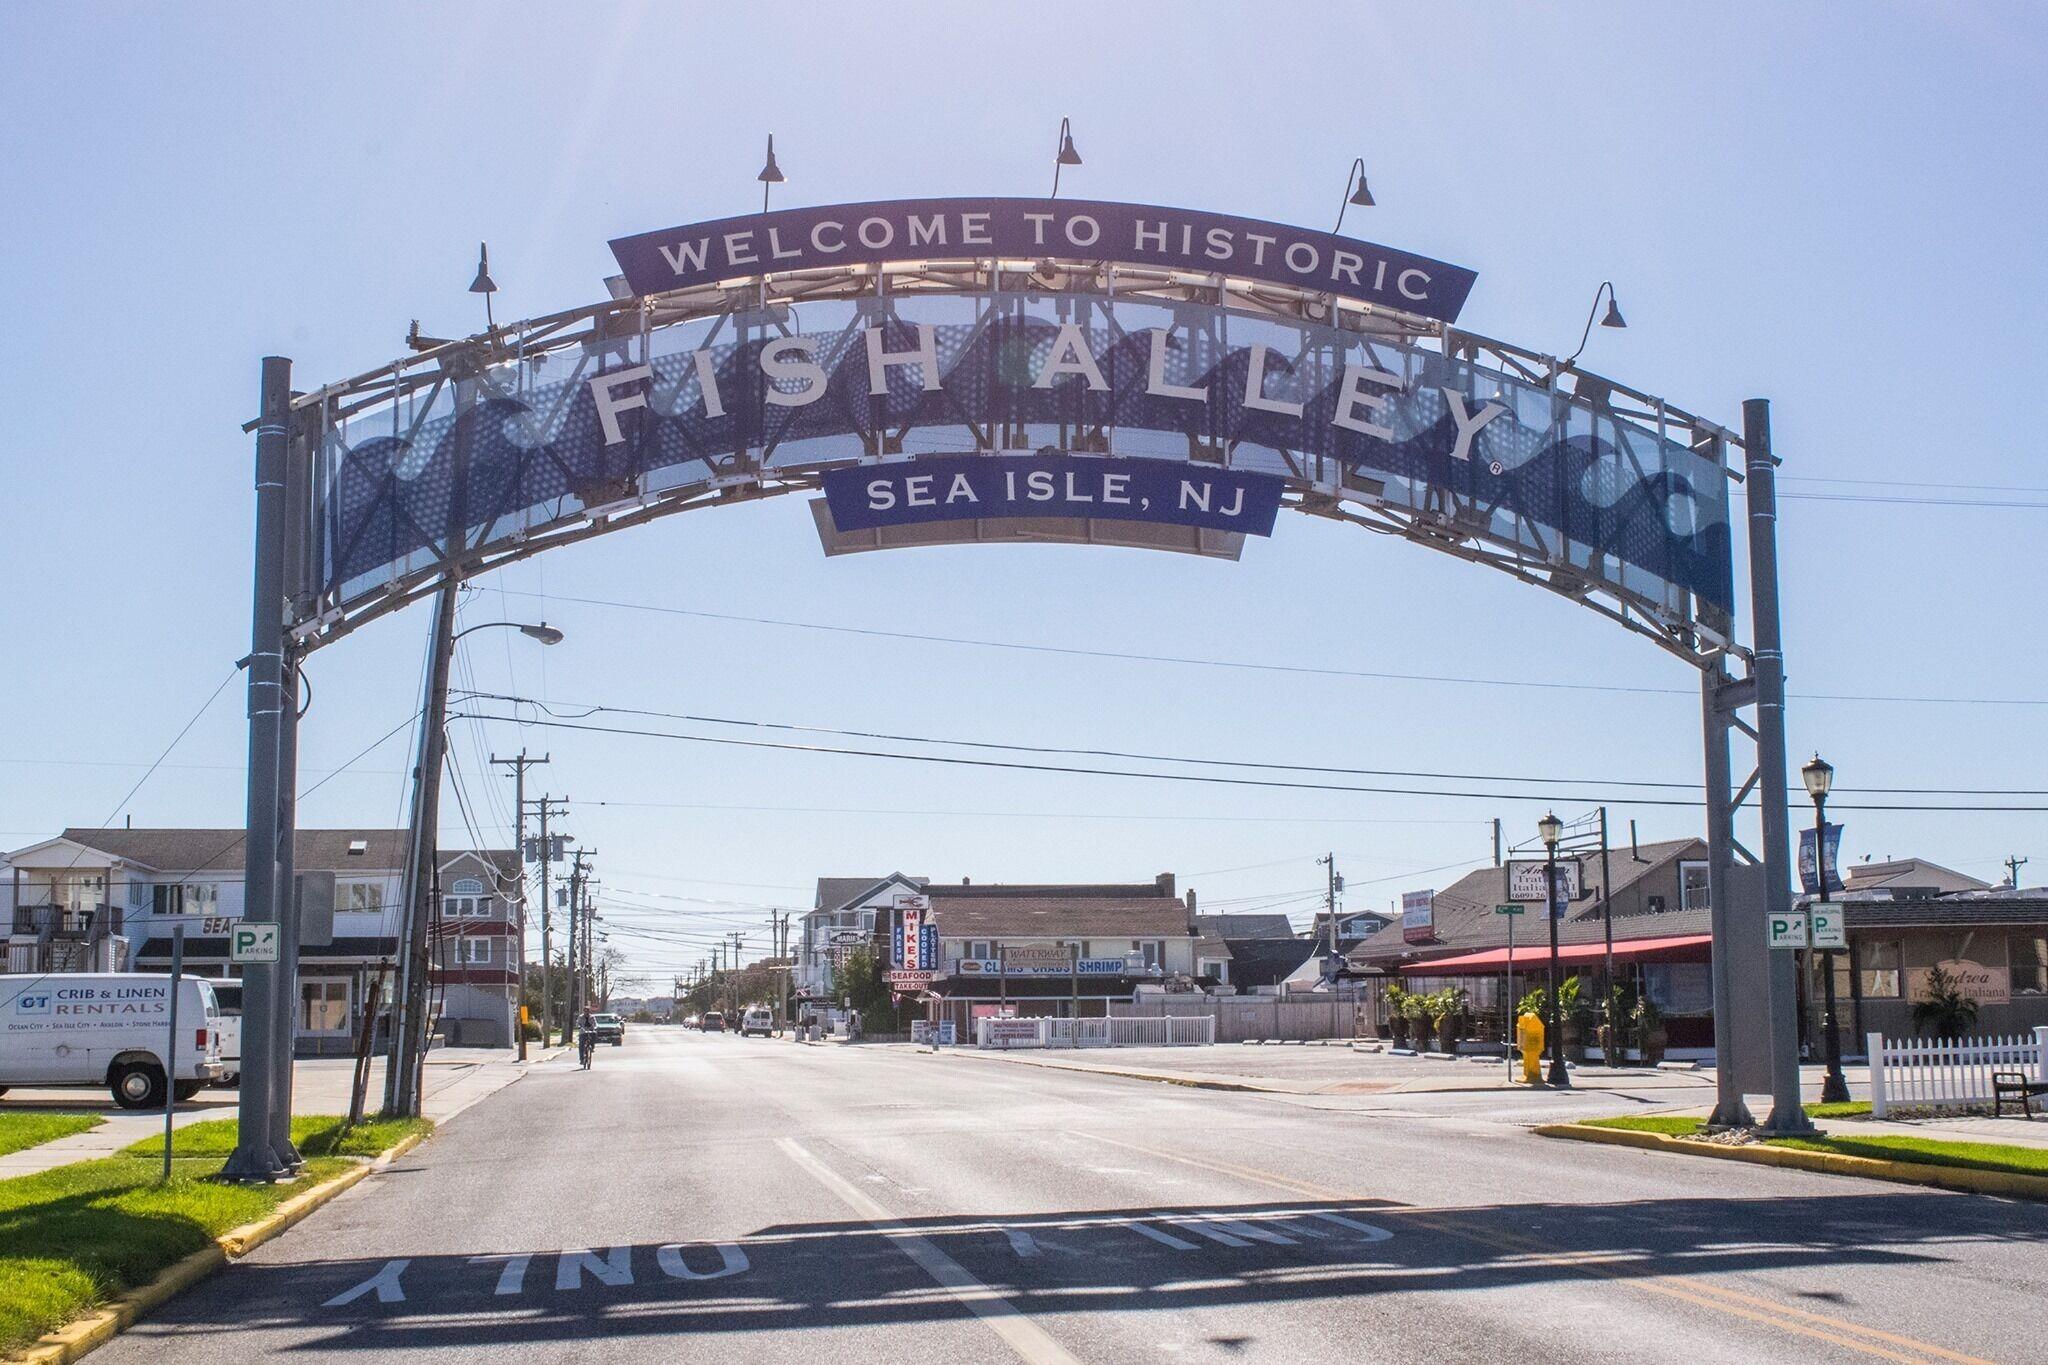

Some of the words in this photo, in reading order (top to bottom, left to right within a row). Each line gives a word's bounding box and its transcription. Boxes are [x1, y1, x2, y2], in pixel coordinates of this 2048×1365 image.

[658, 212, 993, 276] WELCOME
[1023, 212, 1101, 247] TO
[1134, 218, 1432, 301] HISTORIC
[586, 325, 944, 446] FISH
[1031, 323, 1507, 462] ALLEY
[866, 472, 980, 511] SEA
[1005, 471, 1150, 512] ISLE,
[1178, 479, 1245, 517] NJ
[202, 917, 231, 934] SEA
[1772, 920, 1803, 941] PARKING
[1815, 916, 1842, 933] PARKING
[237, 931, 274, 954] PARKING
[906, 911, 918, 969] MIKE'S
[920, 928, 928, 968] COOKED
[1010, 949, 1066, 961] WATERWAY
[1078, 961, 1122, 973] SHRIMP
[891, 972, 932, 981] SEAFOOD
[21, 996, 49, 1008] GT
[57, 989, 95, 999] CRIB
[117, 988, 165, 999] LINEN
[56, 1002, 165, 1015] RENTALS
[320, 1242, 750, 1307] ONLY
